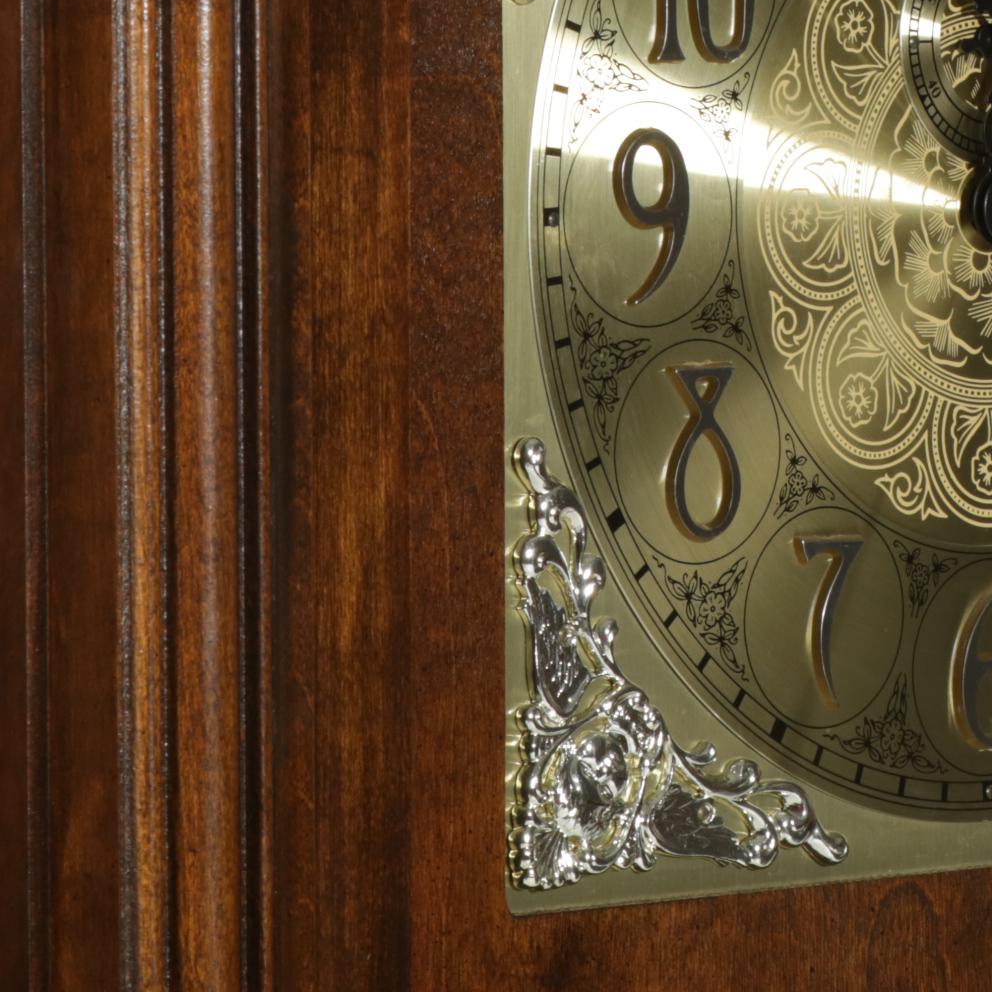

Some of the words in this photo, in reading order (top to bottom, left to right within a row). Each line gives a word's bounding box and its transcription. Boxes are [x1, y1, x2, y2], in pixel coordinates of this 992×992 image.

[928, 80, 942, 98] 40
[611, 126, 691, 306] 9
[661, 360, 742, 542] 8
[793, 531, 865, 710] 7
